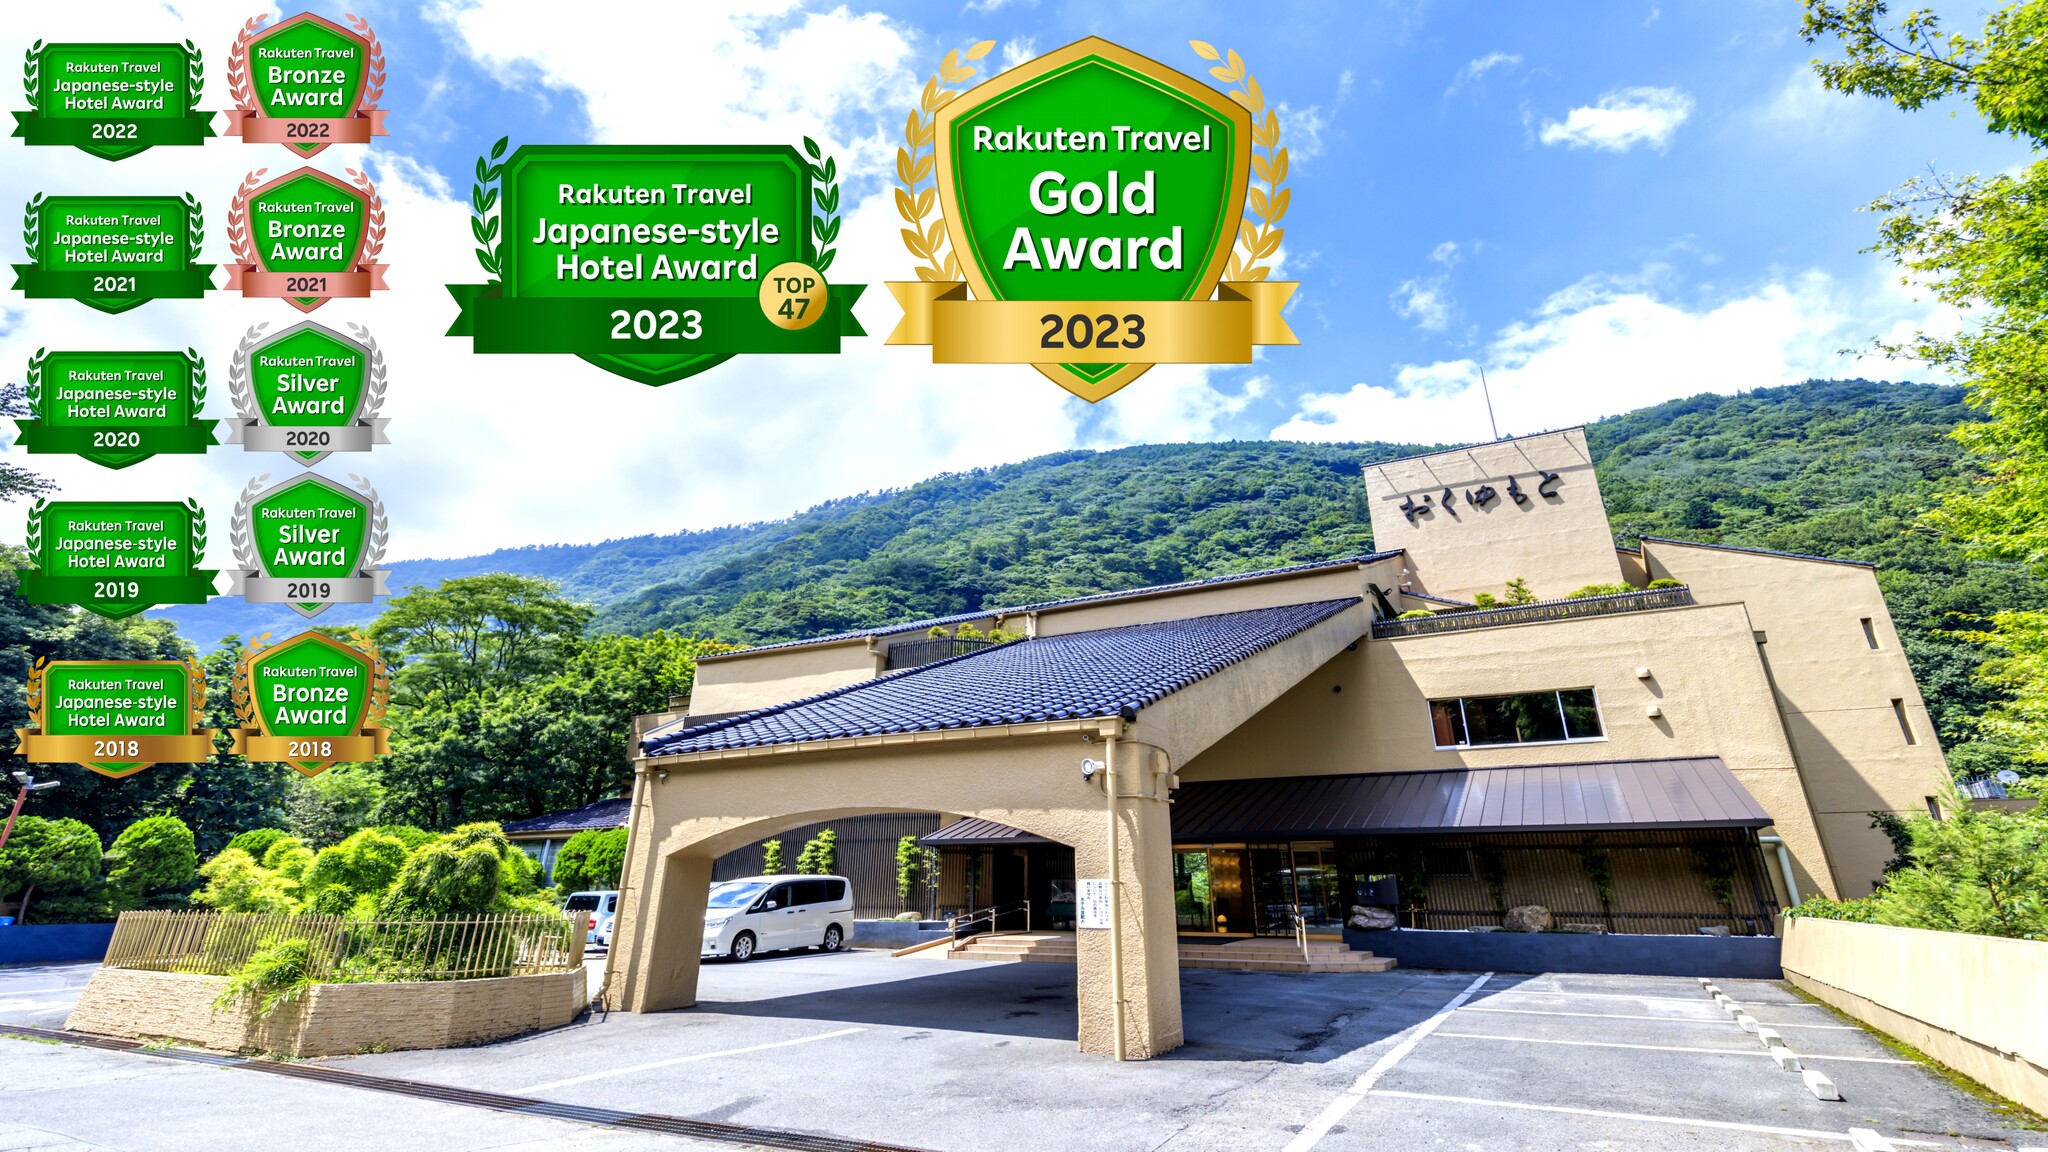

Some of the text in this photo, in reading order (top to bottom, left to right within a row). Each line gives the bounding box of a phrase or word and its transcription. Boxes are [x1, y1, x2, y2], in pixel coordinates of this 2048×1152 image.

[1399, 470, 1559, 522] おくゆもと
